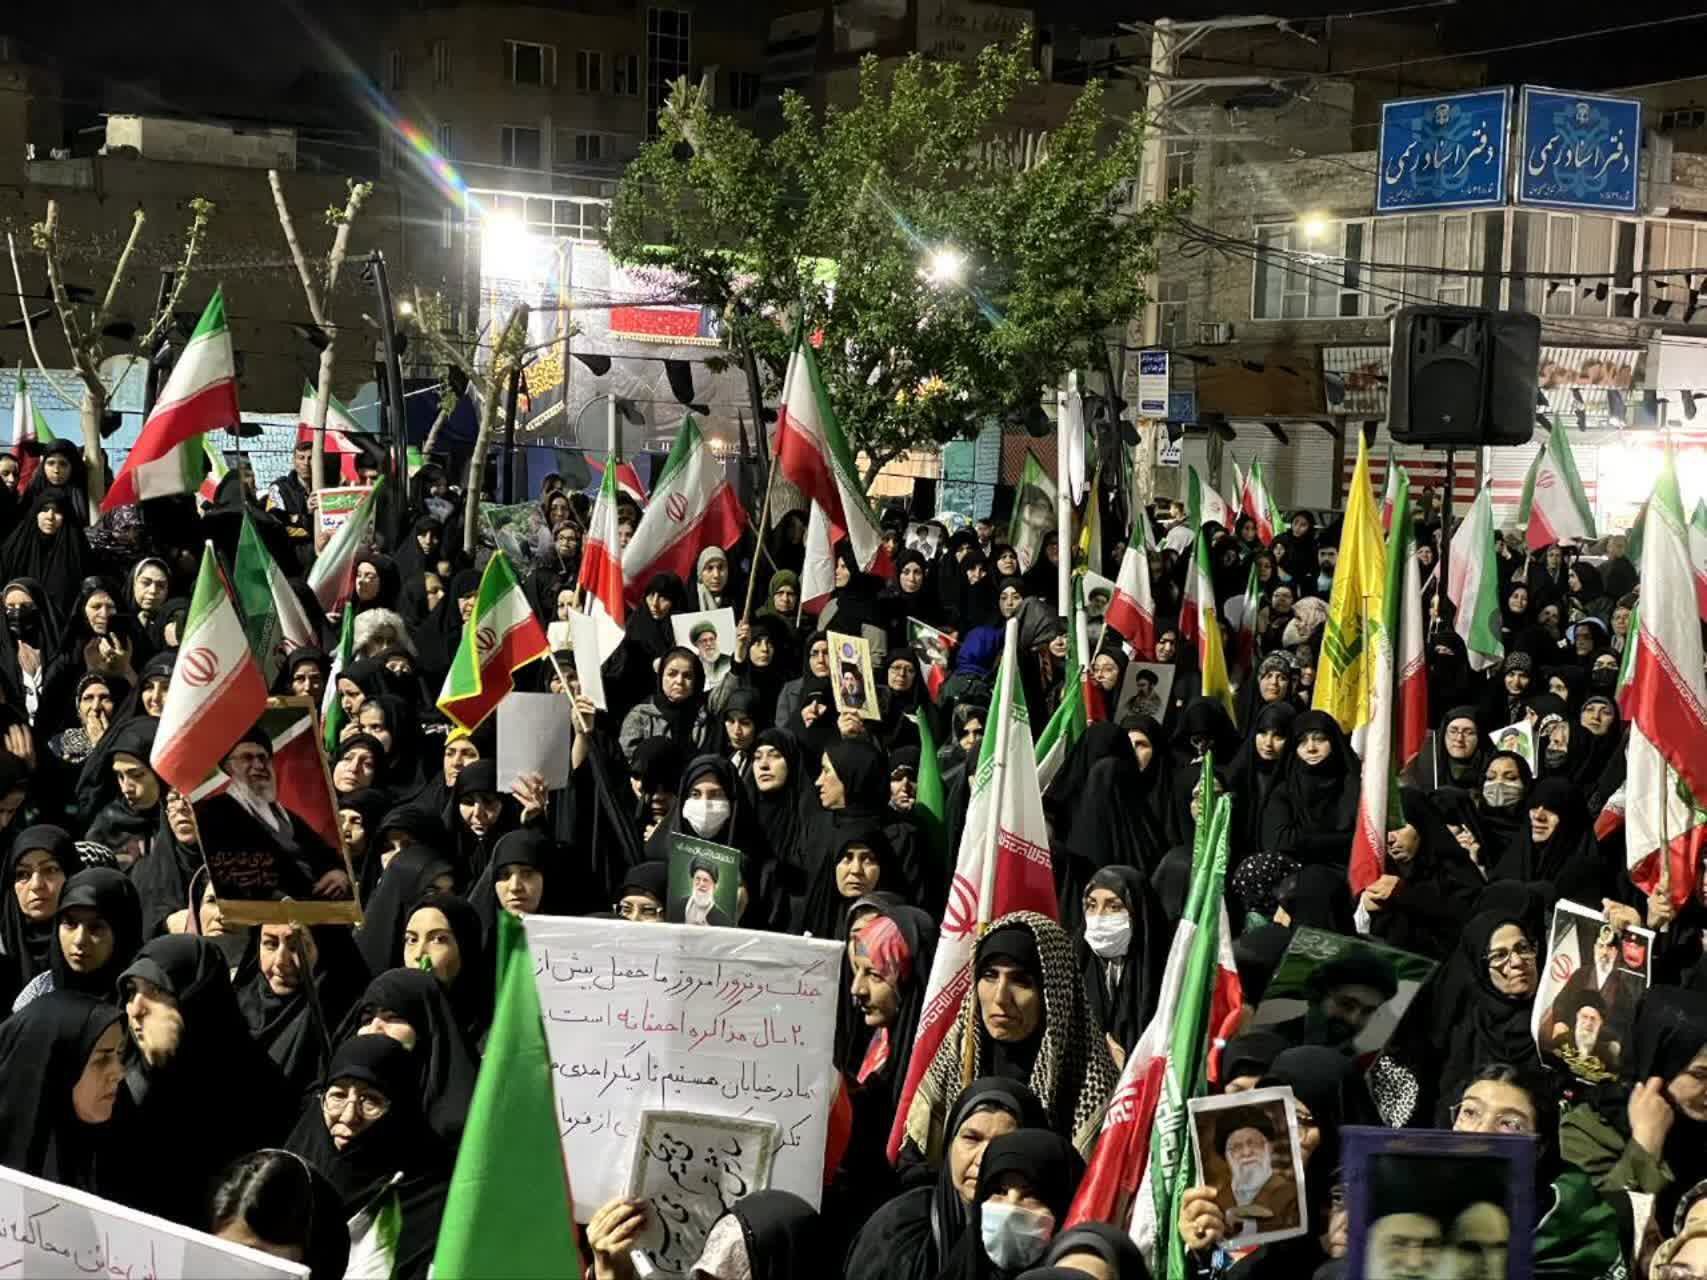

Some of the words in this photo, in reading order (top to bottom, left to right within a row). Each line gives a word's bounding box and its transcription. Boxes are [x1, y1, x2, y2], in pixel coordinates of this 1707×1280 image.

[1385, 141, 1419, 185] رسمی
[1422, 139, 1460, 169] اسناد
[1452, 120, 1494, 178] دفتر
[1528, 134, 1563, 176] رسمی
[1565, 139, 1600, 169] اسناد
[1593, 128, 1629, 180] دفتر
[552, 952, 592, 990] بیش
[664, 962, 721, 1001] امروز
[688, 999, 747, 1052] مذاکره
[753, 1016, 787, 1048] سال
[598, 1040, 647, 1097] دیگر
[647, 1051, 658, 1081] تا
[721, 1061, 776, 1099] خیابان
[661, 1064, 718, 1108] هستیم
[768, 1086, 794, 1102] در
